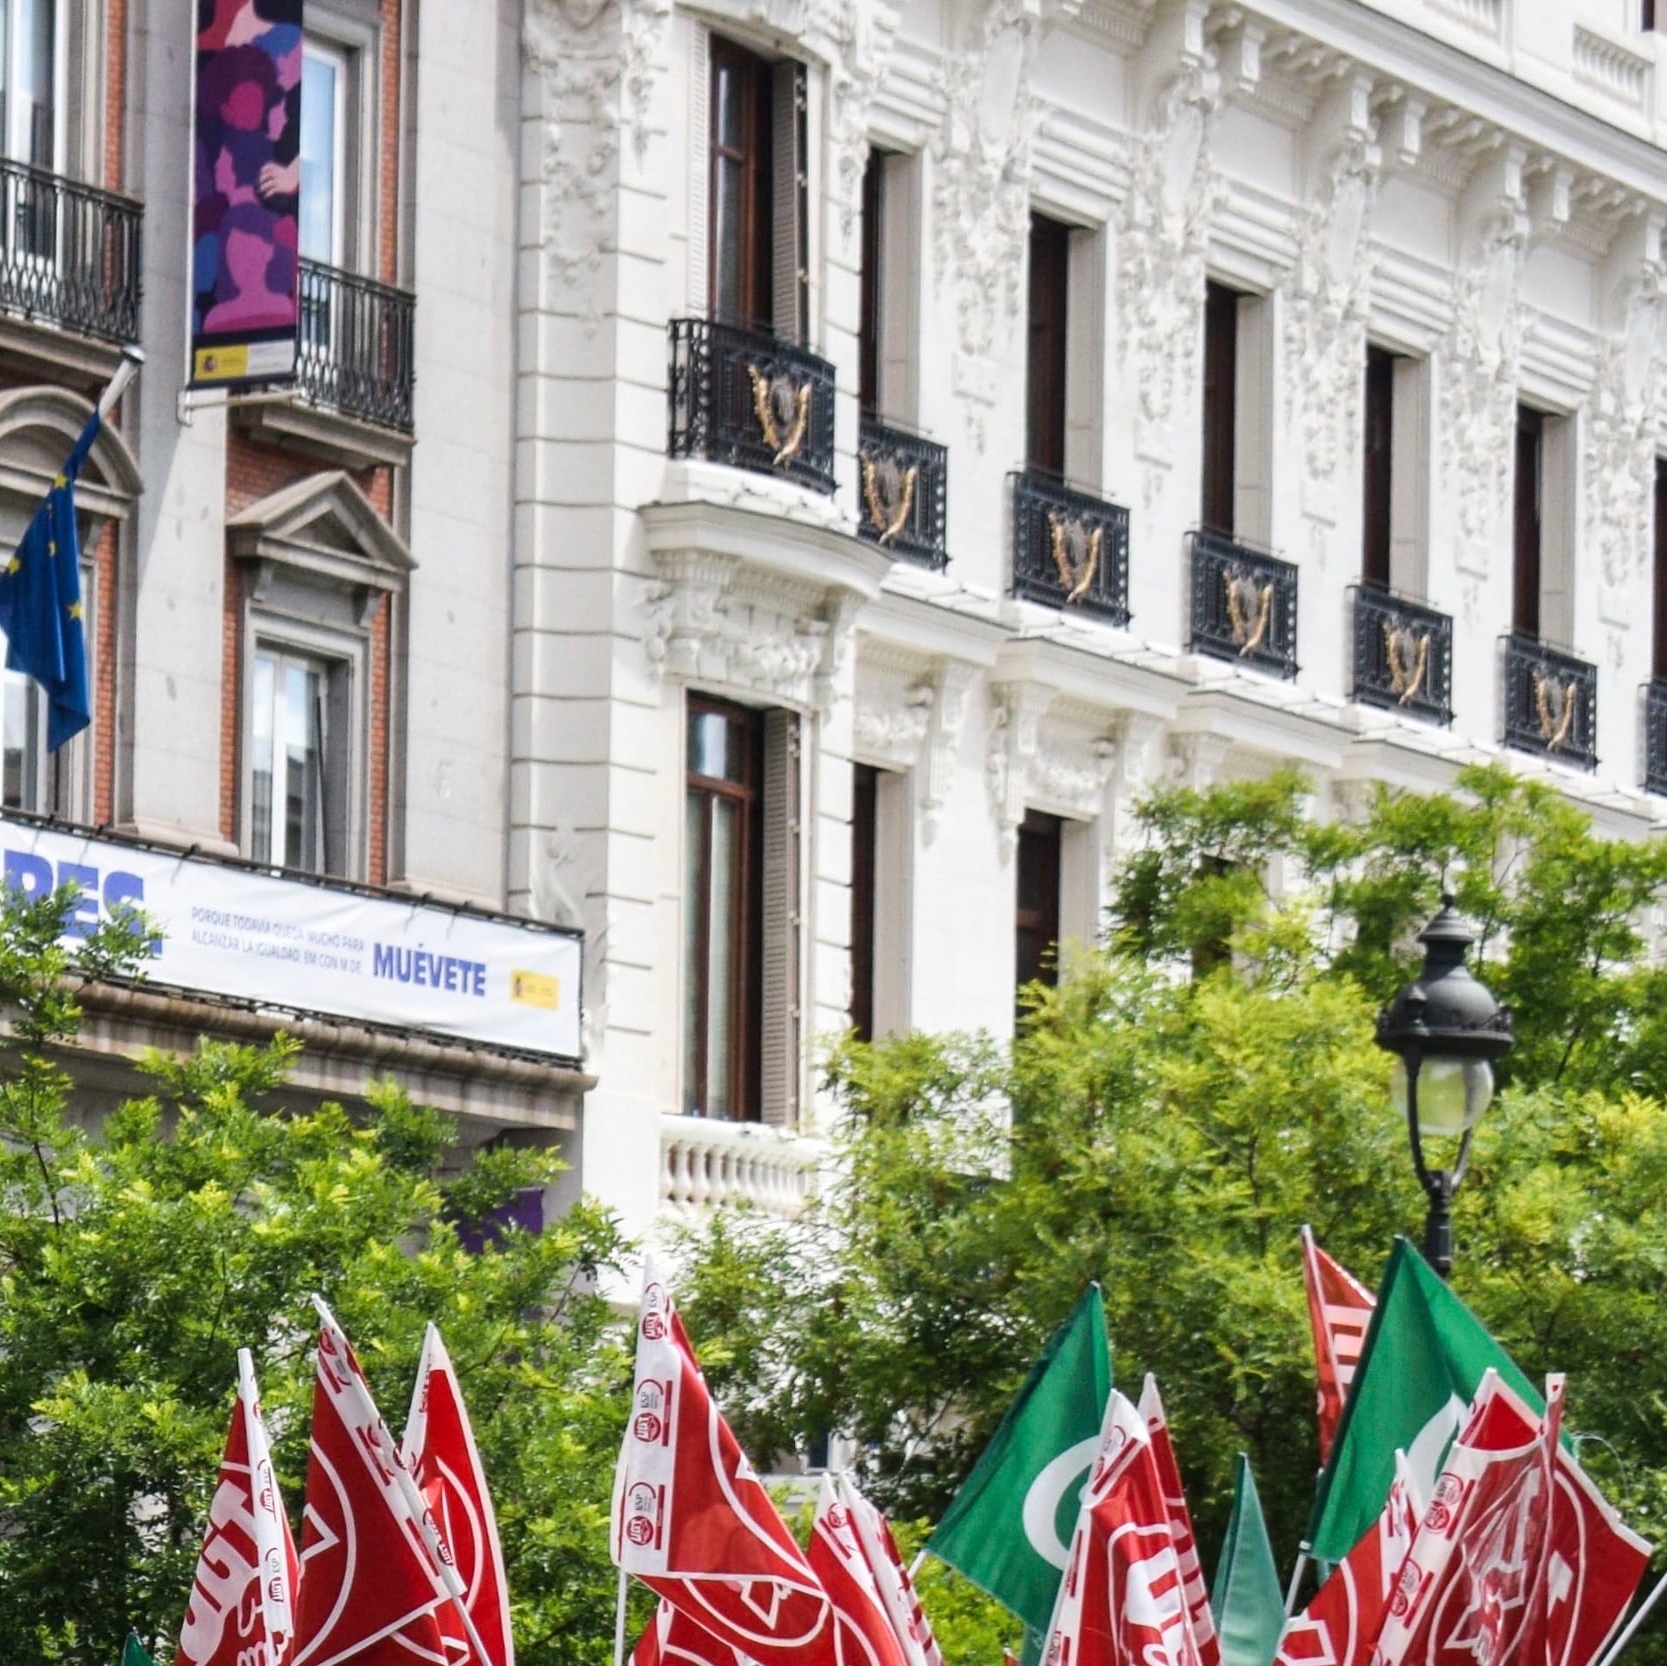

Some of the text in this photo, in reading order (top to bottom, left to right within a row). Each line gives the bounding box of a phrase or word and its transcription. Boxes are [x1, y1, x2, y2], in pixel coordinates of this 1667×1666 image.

[190, 929, 240, 953] ALCANZAR
[241, 939, 254, 956] LA
[341, 934, 365, 953] PARA
[373, 942, 487, 998] MUÉVETE
